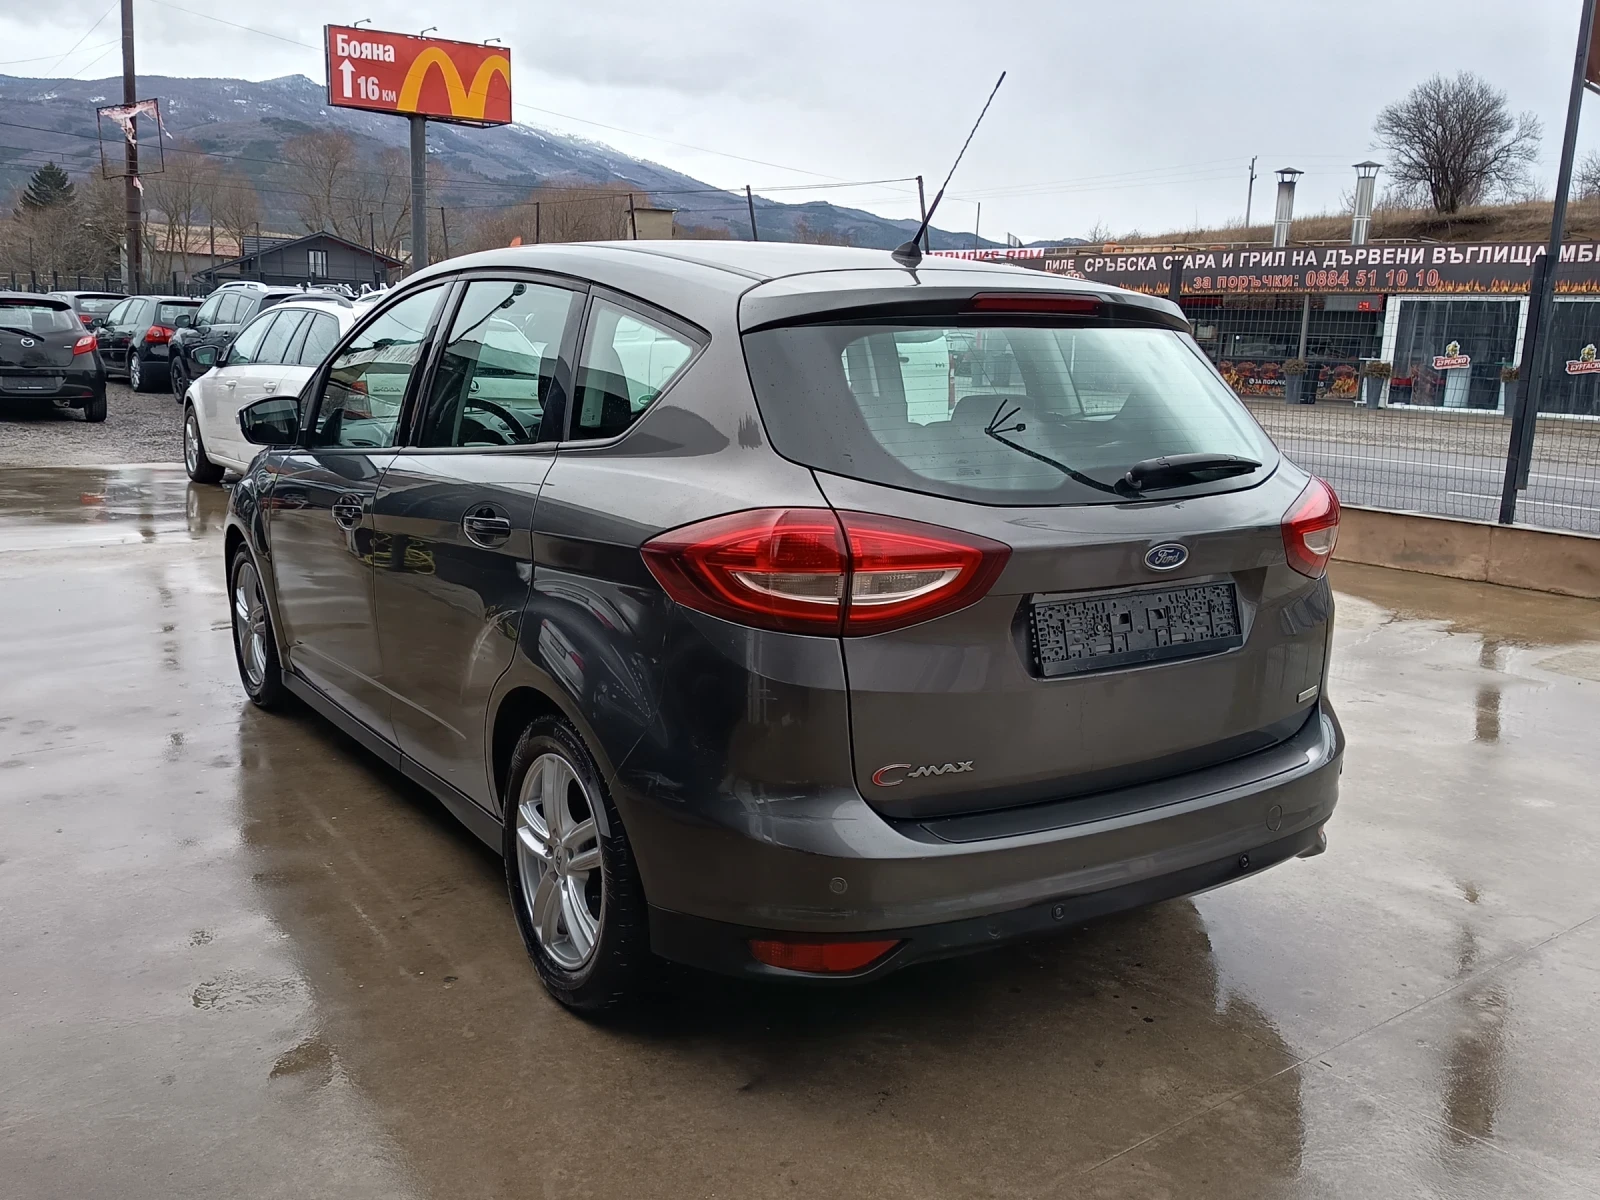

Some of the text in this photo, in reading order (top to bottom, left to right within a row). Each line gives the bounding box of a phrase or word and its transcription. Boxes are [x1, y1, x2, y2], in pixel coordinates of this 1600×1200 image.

[336, 33, 395, 63] Бояна
[357, 75, 380, 101] 16
[1045, 259, 1075, 270] ПИЛЕ
[1084, 256, 1157, 273] СРЪБСКА
[1162, 253, 1216, 270] САРА
[1221, 253, 1234, 269] И
[1239, 251, 1286, 268] ГРИЛ
[1291, 250, 1317, 267] НА
[1322, 247, 1425, 269] ДЪРВЕНИ
[1193, 276, 1212, 289] за
[1305, 269, 1350, 288] 0884
[1355, 269, 1377, 288] 51
[1385, 268, 1409, 287] 10
[1415, 268, 1440, 287] 10
